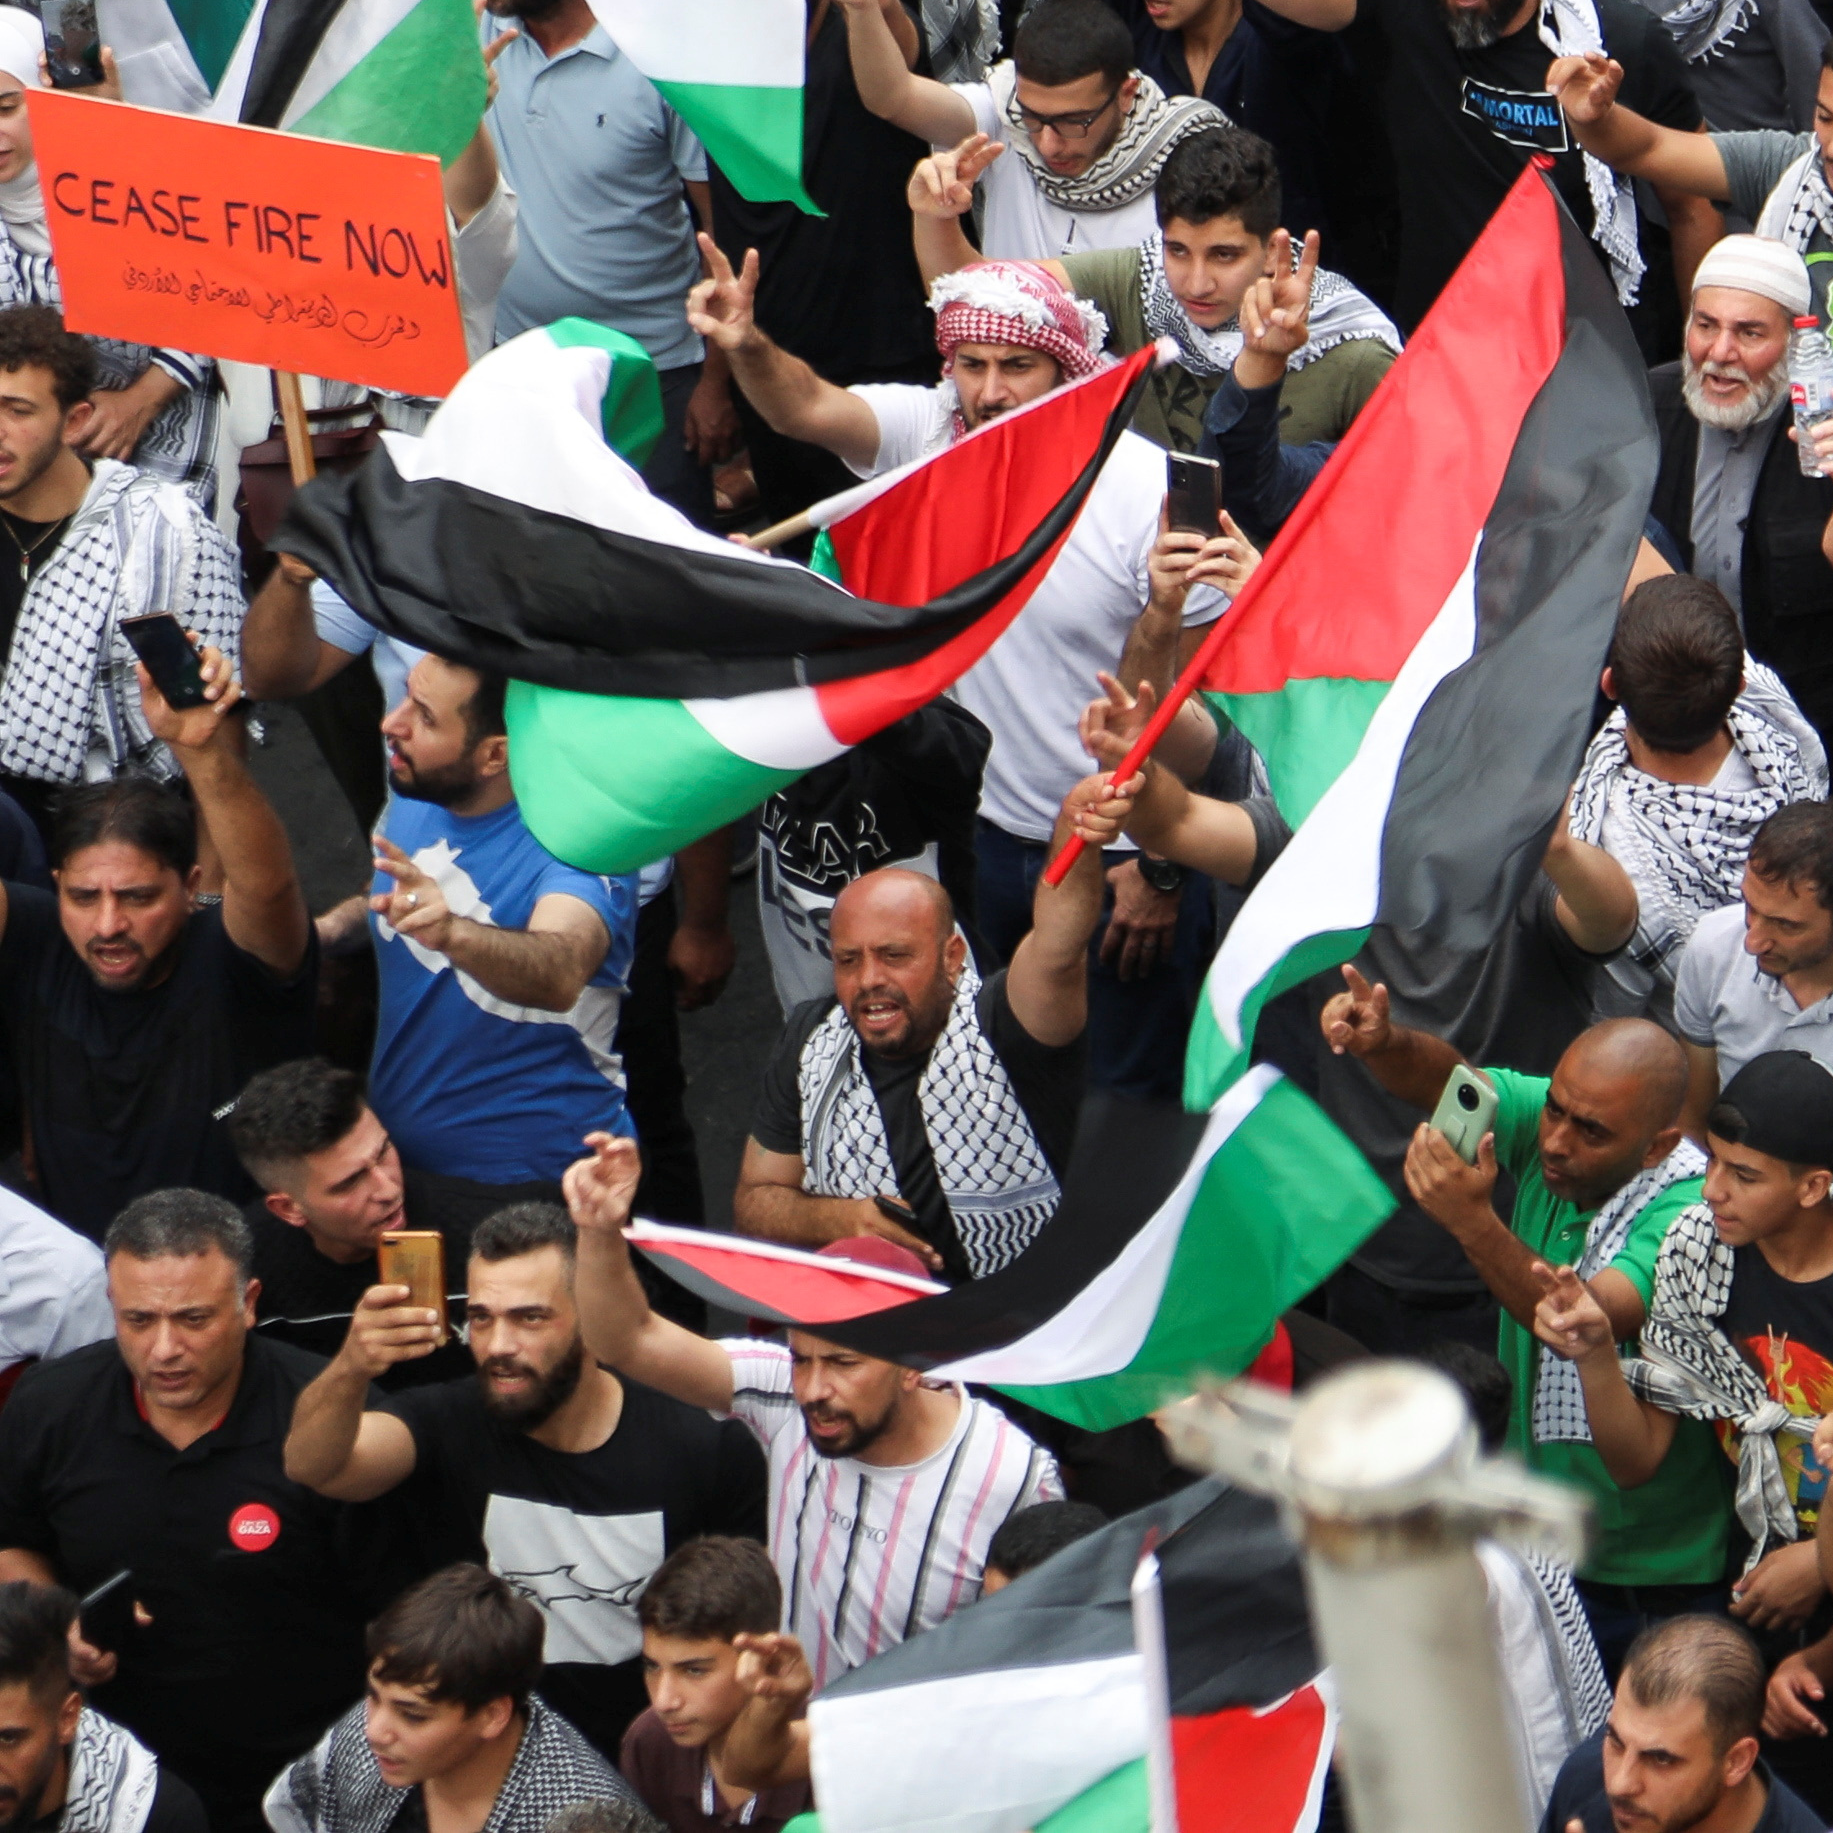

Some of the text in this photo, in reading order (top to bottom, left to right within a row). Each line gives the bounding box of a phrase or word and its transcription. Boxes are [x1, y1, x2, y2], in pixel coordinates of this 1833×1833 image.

[53, 172, 447, 289] CEASE FIRE NOW
[238, 1524, 272, 1536] GAZA
[829, 1509, 889, 1545] TOYO
